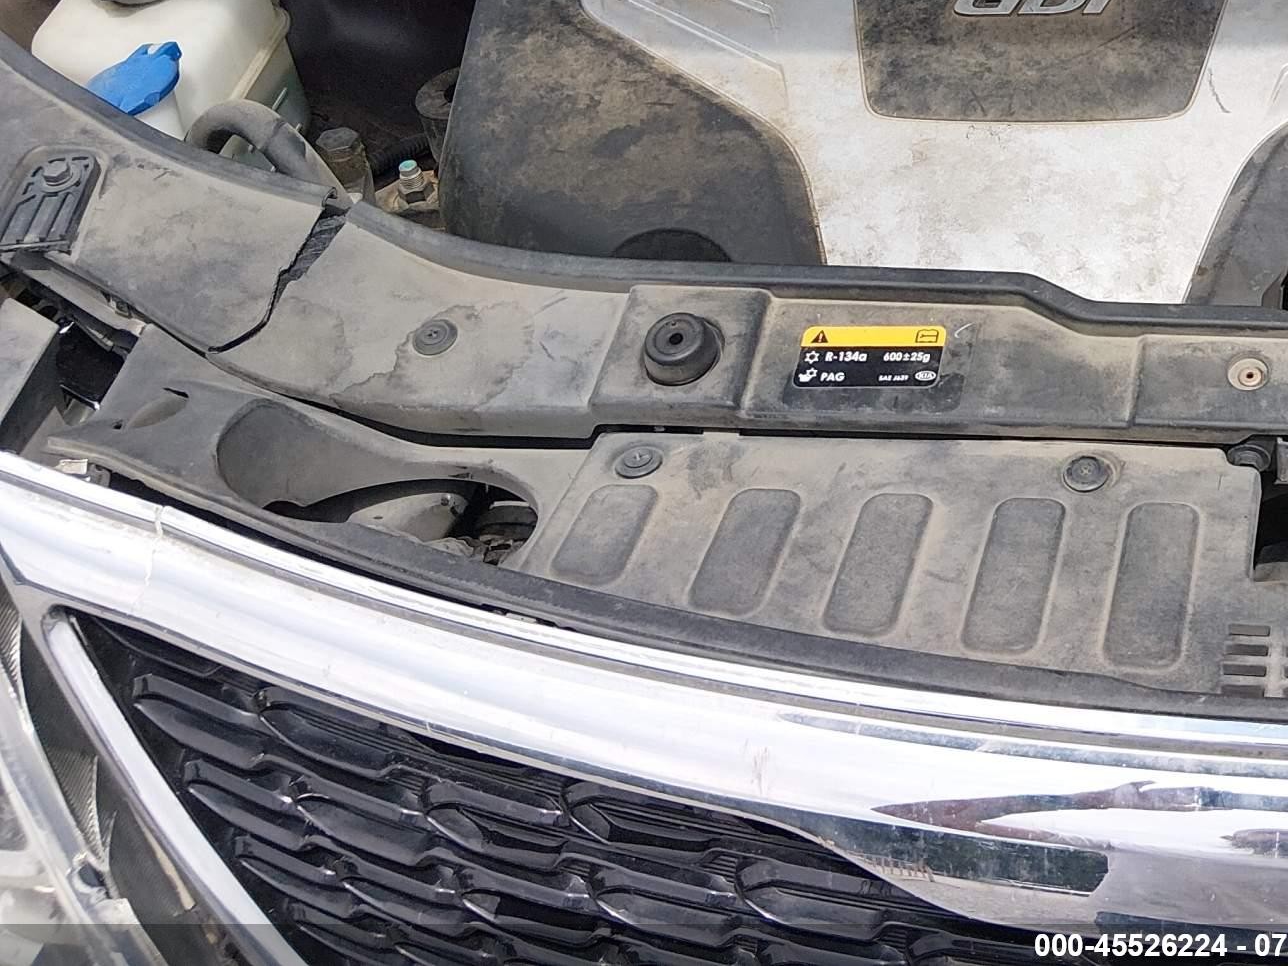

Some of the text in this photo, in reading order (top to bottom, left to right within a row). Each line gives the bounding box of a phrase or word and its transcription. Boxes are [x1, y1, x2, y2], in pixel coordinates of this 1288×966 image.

[825, 352, 930, 363] R-134a 600±25g
[820, 372, 845, 381] PAG
